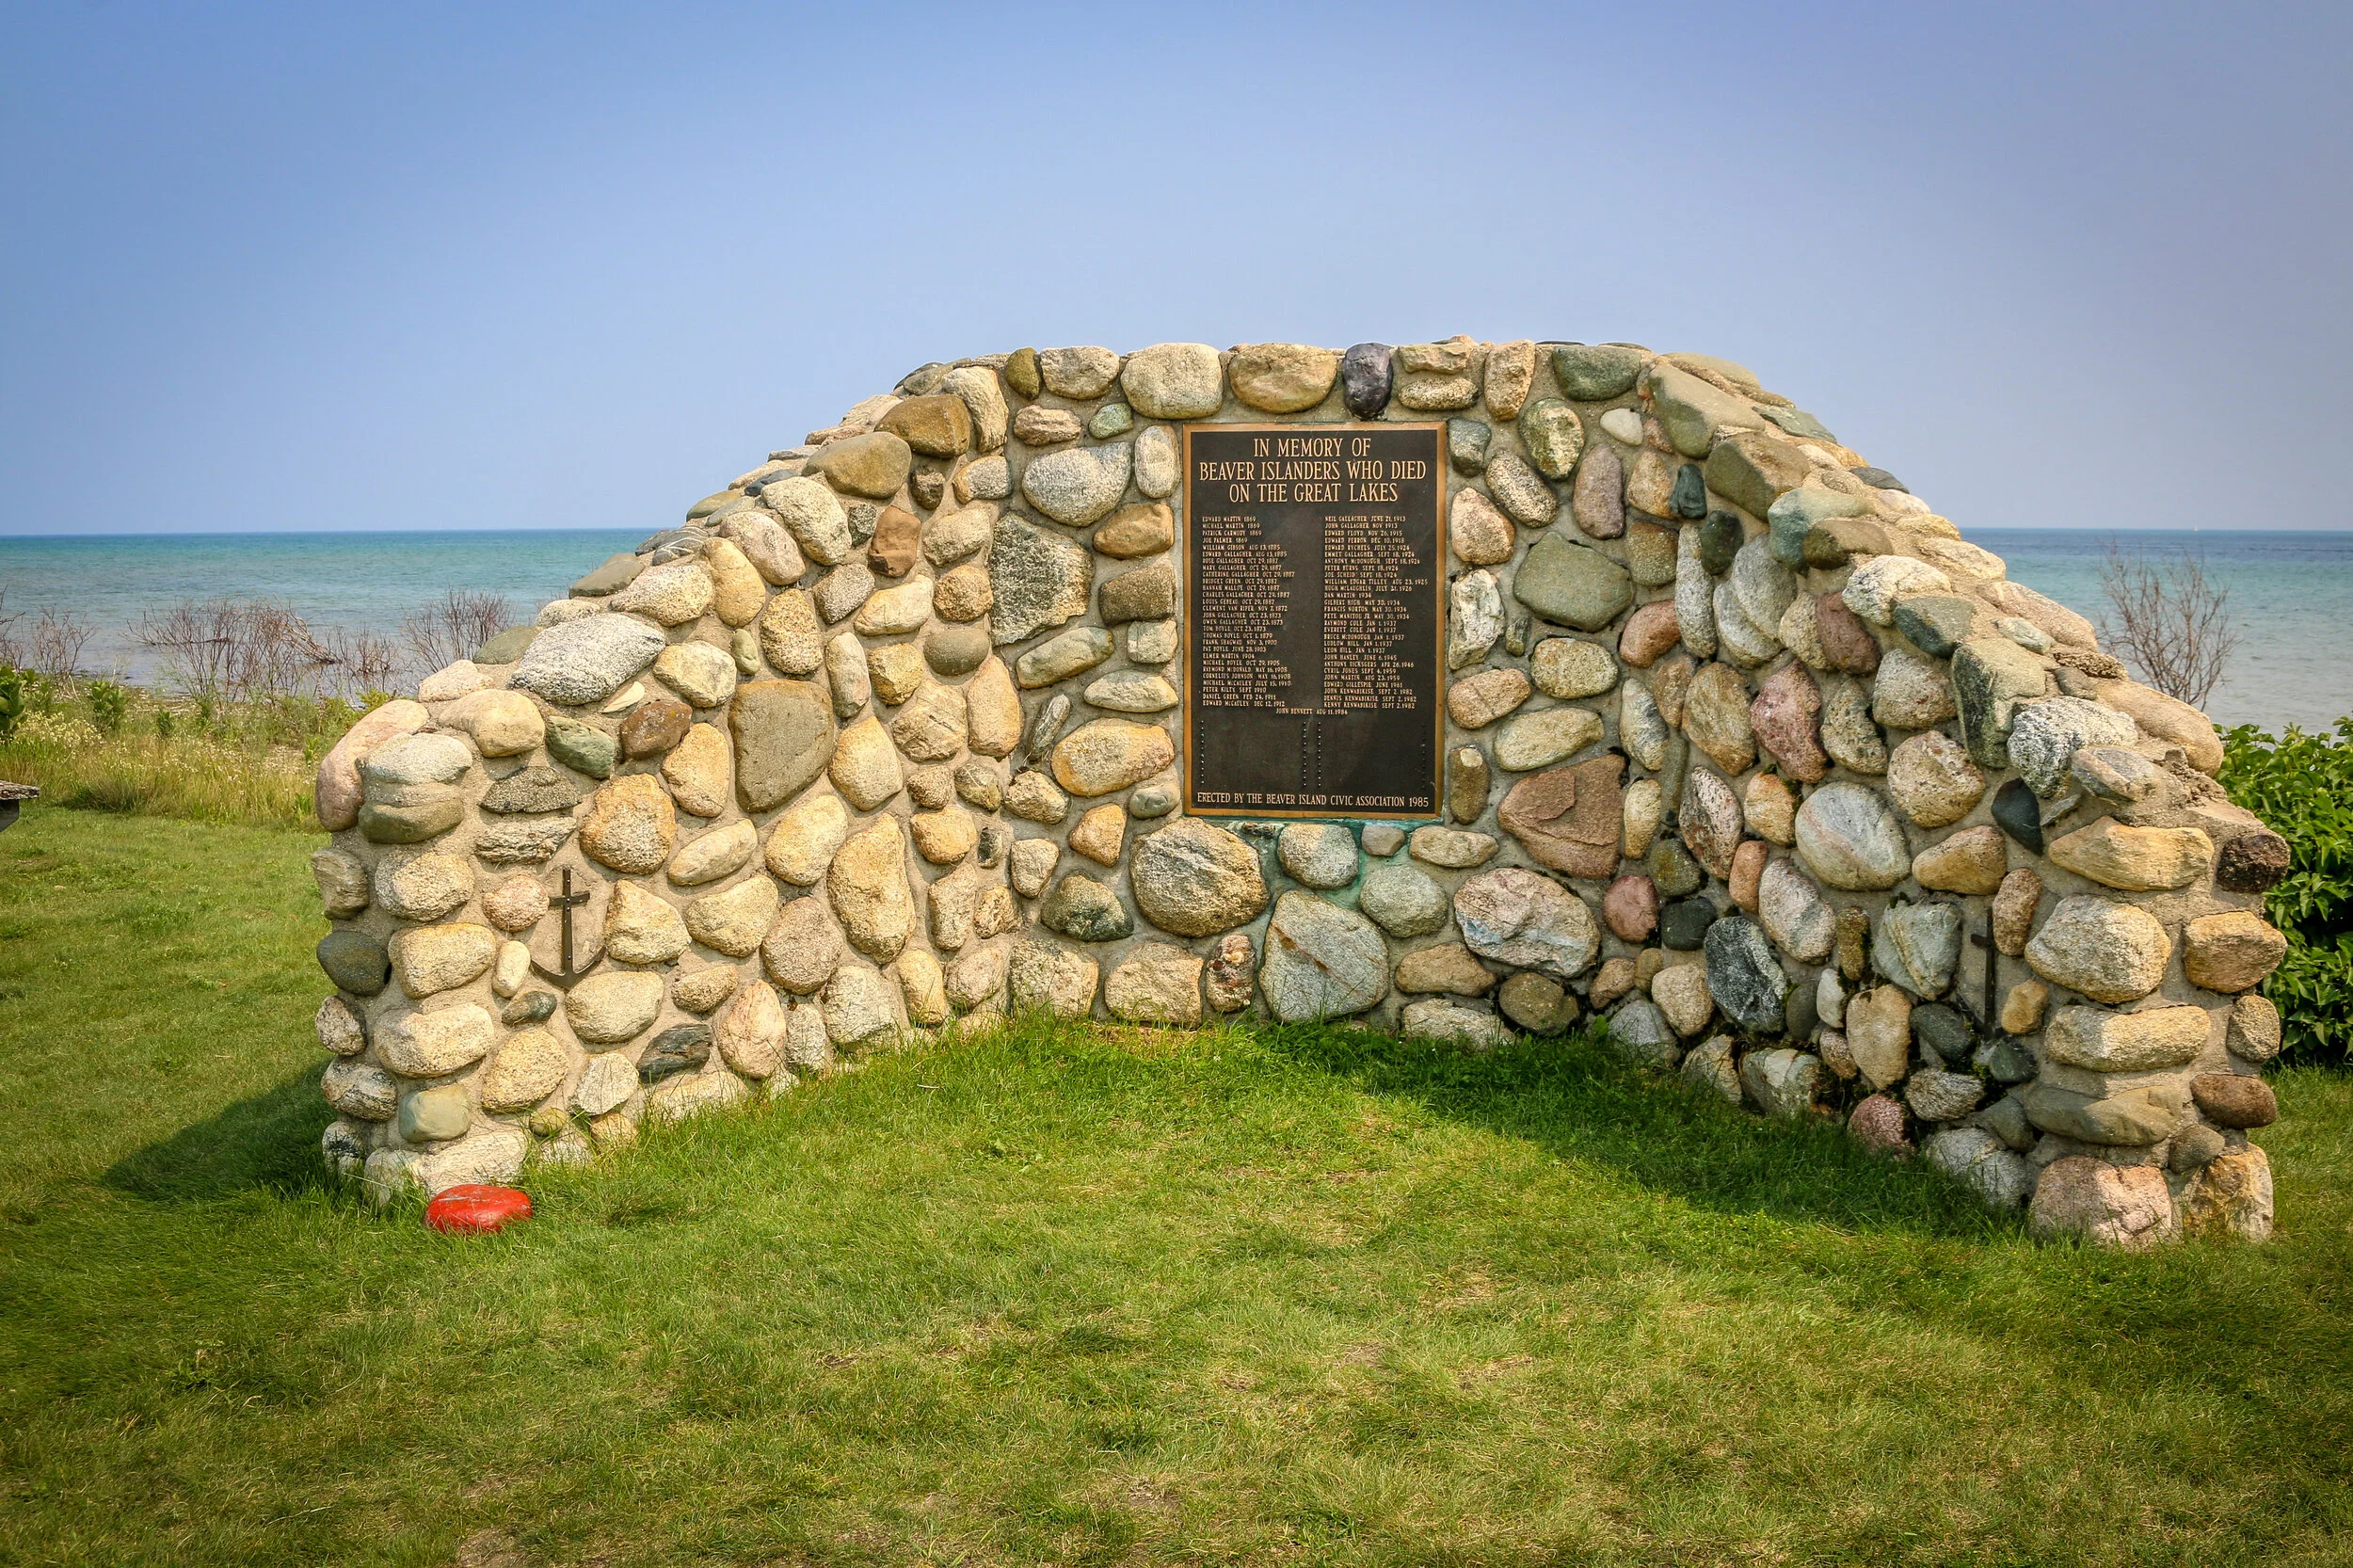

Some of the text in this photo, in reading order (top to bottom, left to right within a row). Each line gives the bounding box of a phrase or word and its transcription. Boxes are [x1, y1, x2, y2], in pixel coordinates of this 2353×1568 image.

[1254, 438, 1371, 457] IN MEMORY OF
[1200, 460, 1426, 480] BEAVER ISLANDERS WHO DIED
[1229, 483, 1399, 503] ON THE GREAT LAKES
[1197, 792, 1429, 807] ERECTED BY THE BEAVER ISLAND CIVIC ASSOCIATION 1985
